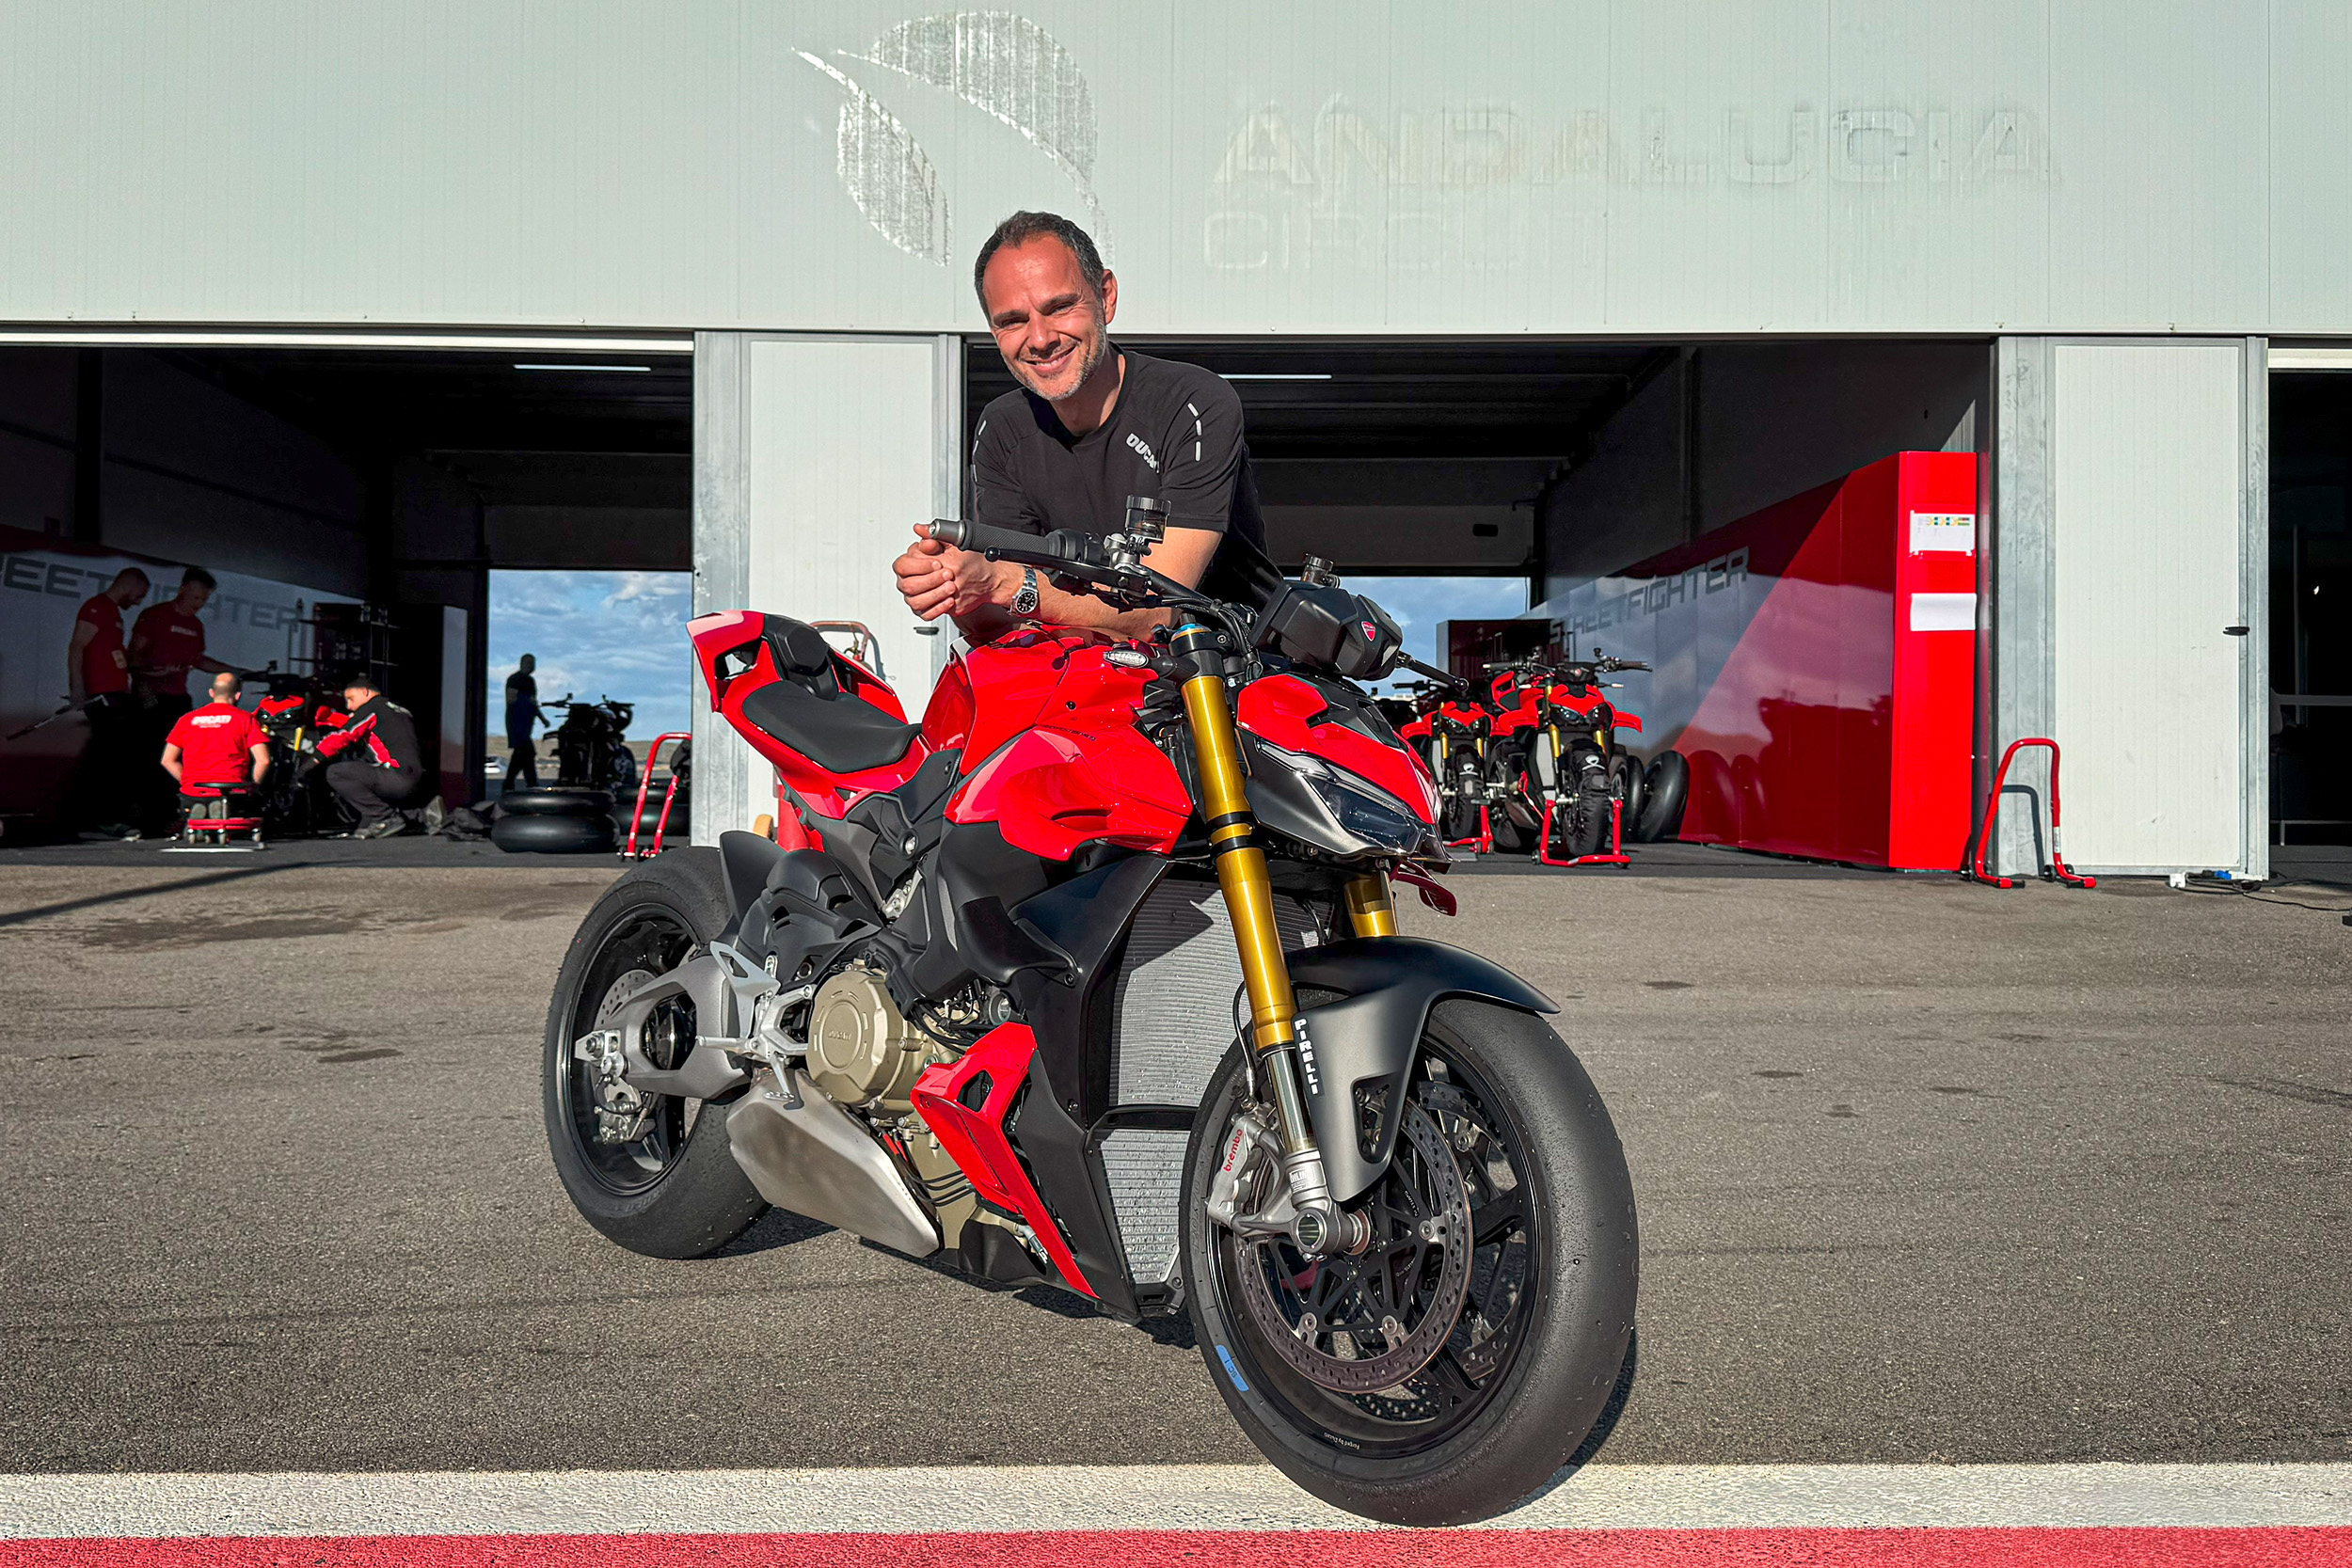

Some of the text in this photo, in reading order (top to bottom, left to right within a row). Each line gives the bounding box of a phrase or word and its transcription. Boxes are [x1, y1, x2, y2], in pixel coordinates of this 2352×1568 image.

[1213, 106, 2060, 185] ANDALUCIA
[1295, 1019, 1318, 1095] PIRELLI
[1223, 1129, 1243, 1172] brembo
